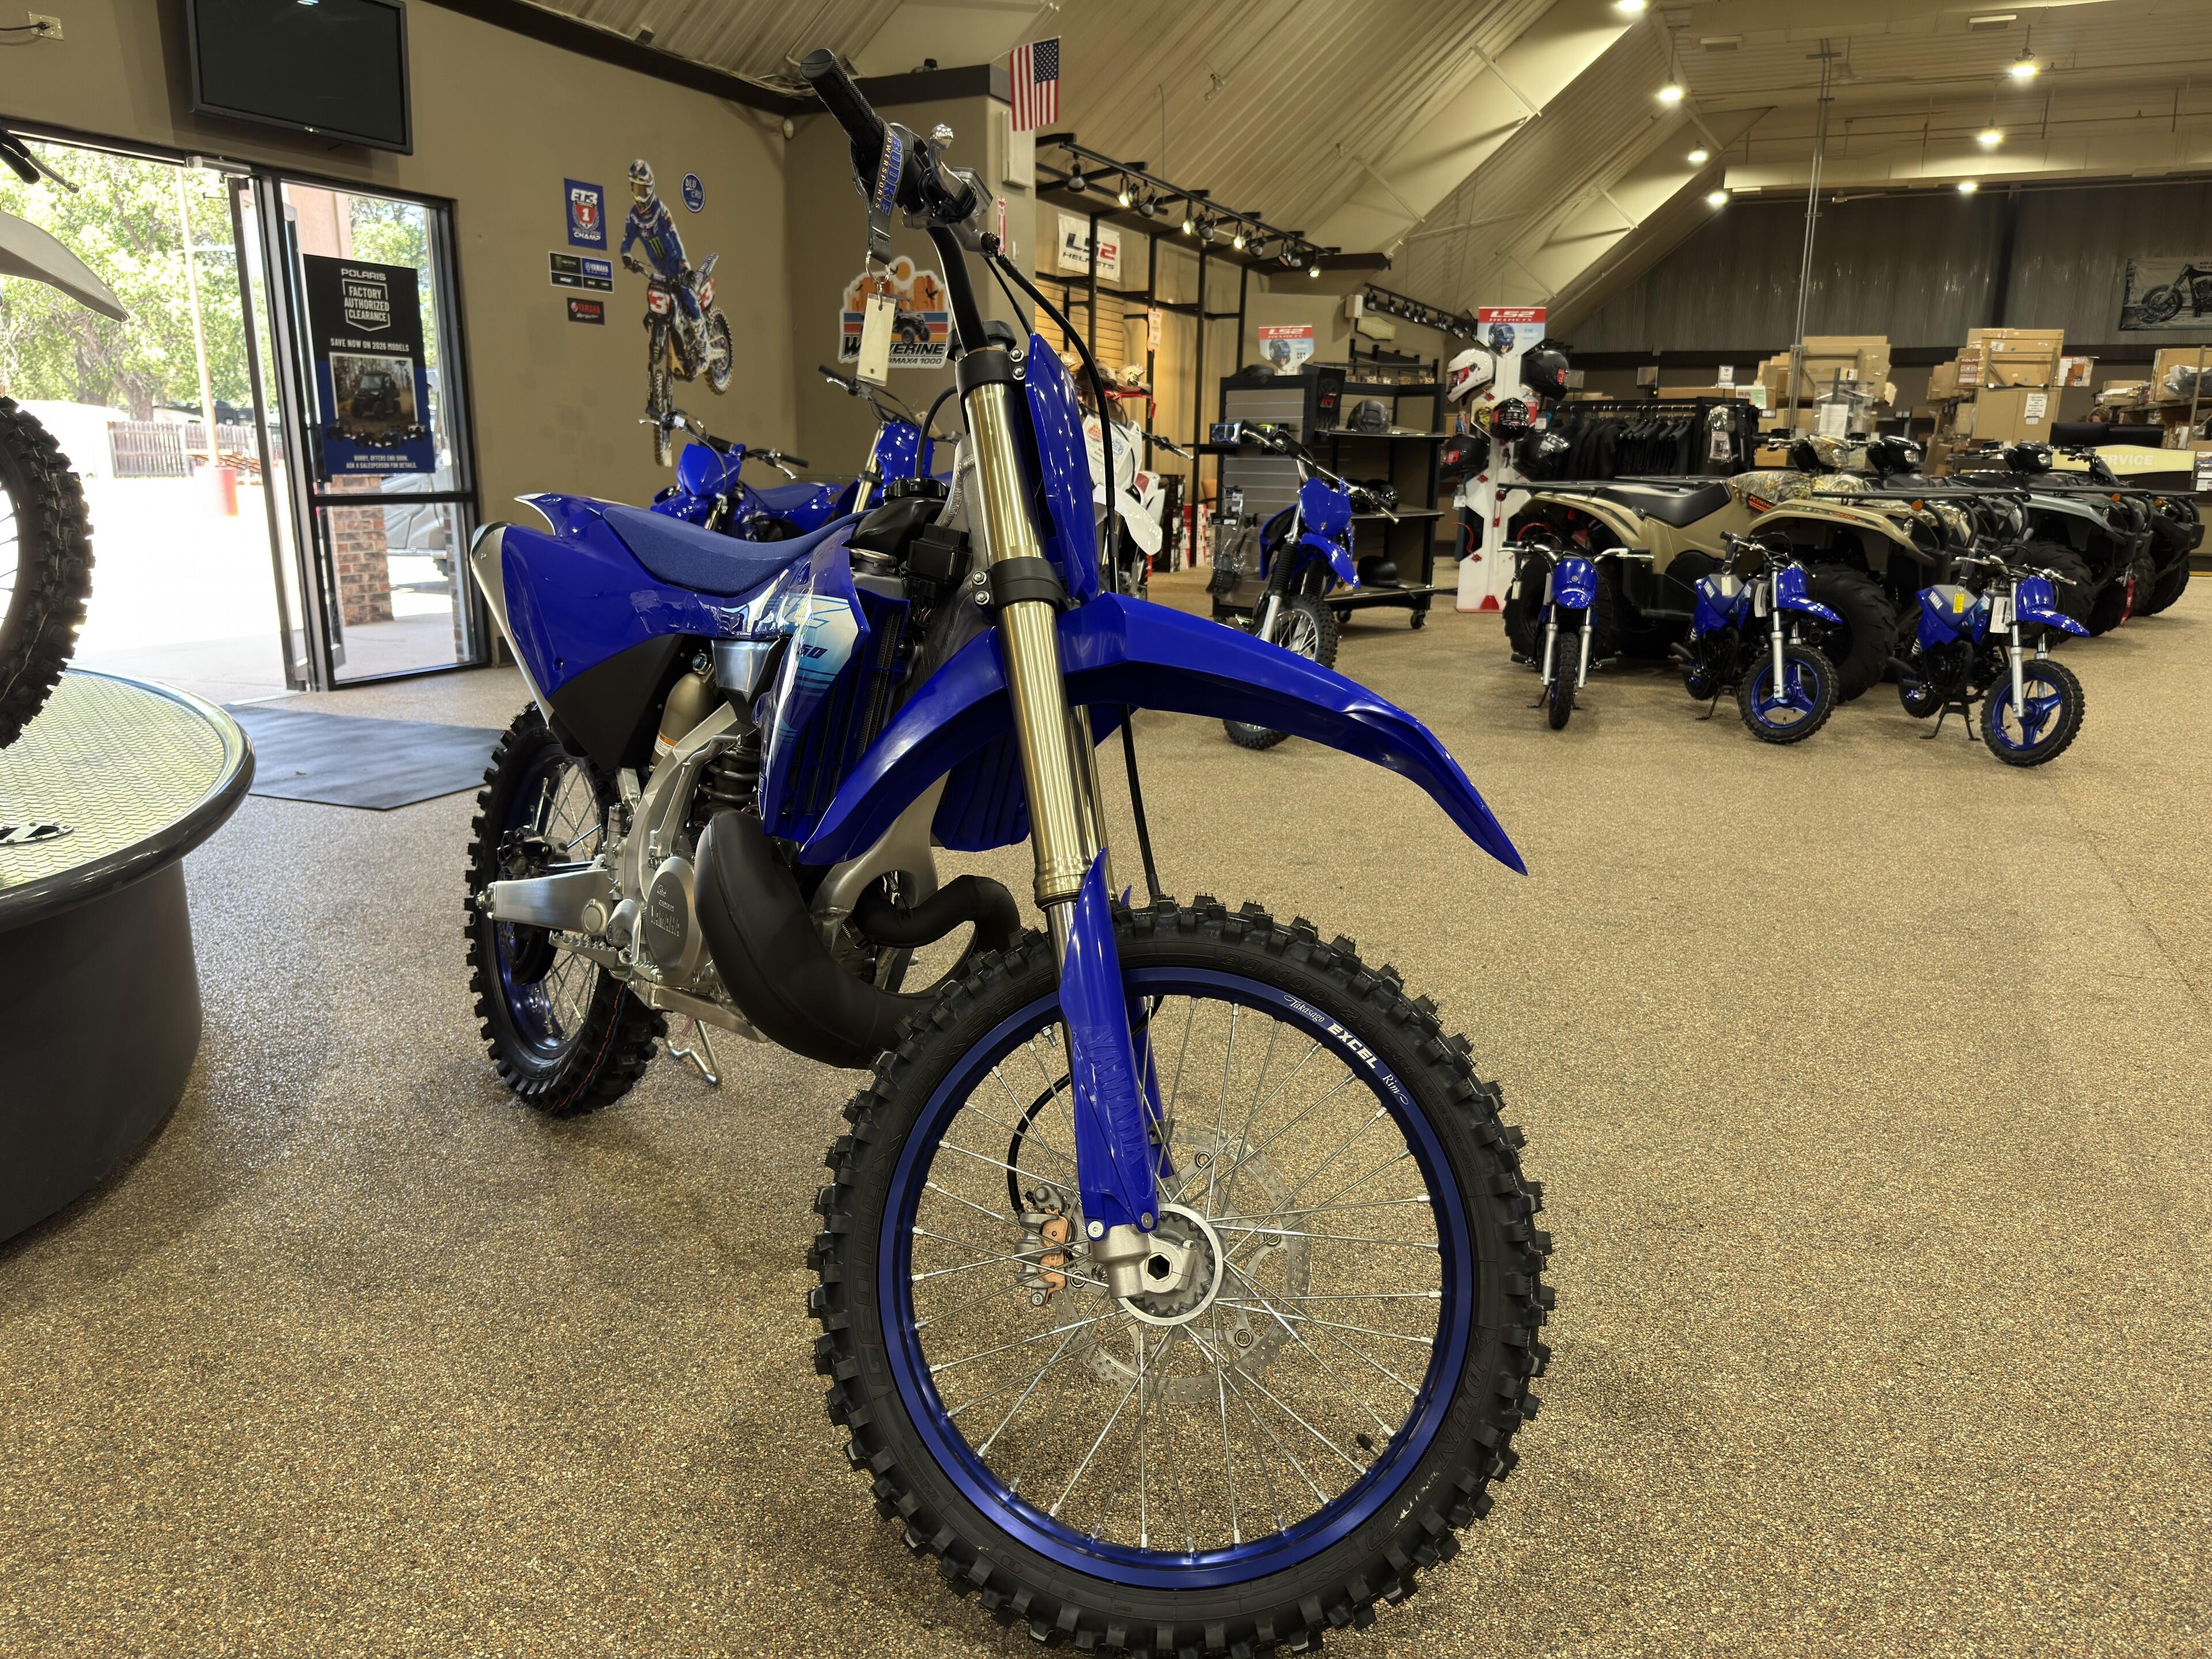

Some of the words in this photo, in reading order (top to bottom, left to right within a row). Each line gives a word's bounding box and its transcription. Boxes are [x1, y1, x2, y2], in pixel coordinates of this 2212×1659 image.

[875, 130, 892, 209] POWERSPORTS
[879, 134, 903, 216] BUDKE
[570, 188, 598, 206] ET3
[582, 208, 590, 222] 1
[574, 232, 601, 241] CHAMP
[341, 268, 387, 281] POLARIS
[590, 263, 609, 273] YAMAHA
[349, 286, 382, 300] FACTORY
[649, 291, 668, 315] 3
[699, 281, 715, 308] 3
[344, 298, 390, 312] AUTHORIZED
[578, 303, 601, 315] YAMAHA
[348, 309, 388, 322] CLEARANCE
[330, 338, 346, 347] SAVE
[347, 339, 362, 349] NOW
[362, 340, 372, 349] ON
[387, 343, 410, 352] MODELS
[843, 335, 946, 358] WVERINE
[2102, 453, 2154, 466] ERVICE
[1927, 590, 1943, 610] YAMAHA
[651, 905, 680, 937] YAMAHA
[1283, 995, 1325, 1022] Takasago
[1327, 1022, 1378, 1069] EXCEL
[1085, 1027, 1145, 1165] YAMAHA
[1382, 1074, 1408, 1105] Rim
[1366, 1355, 1490, 1552] DUNLOP
